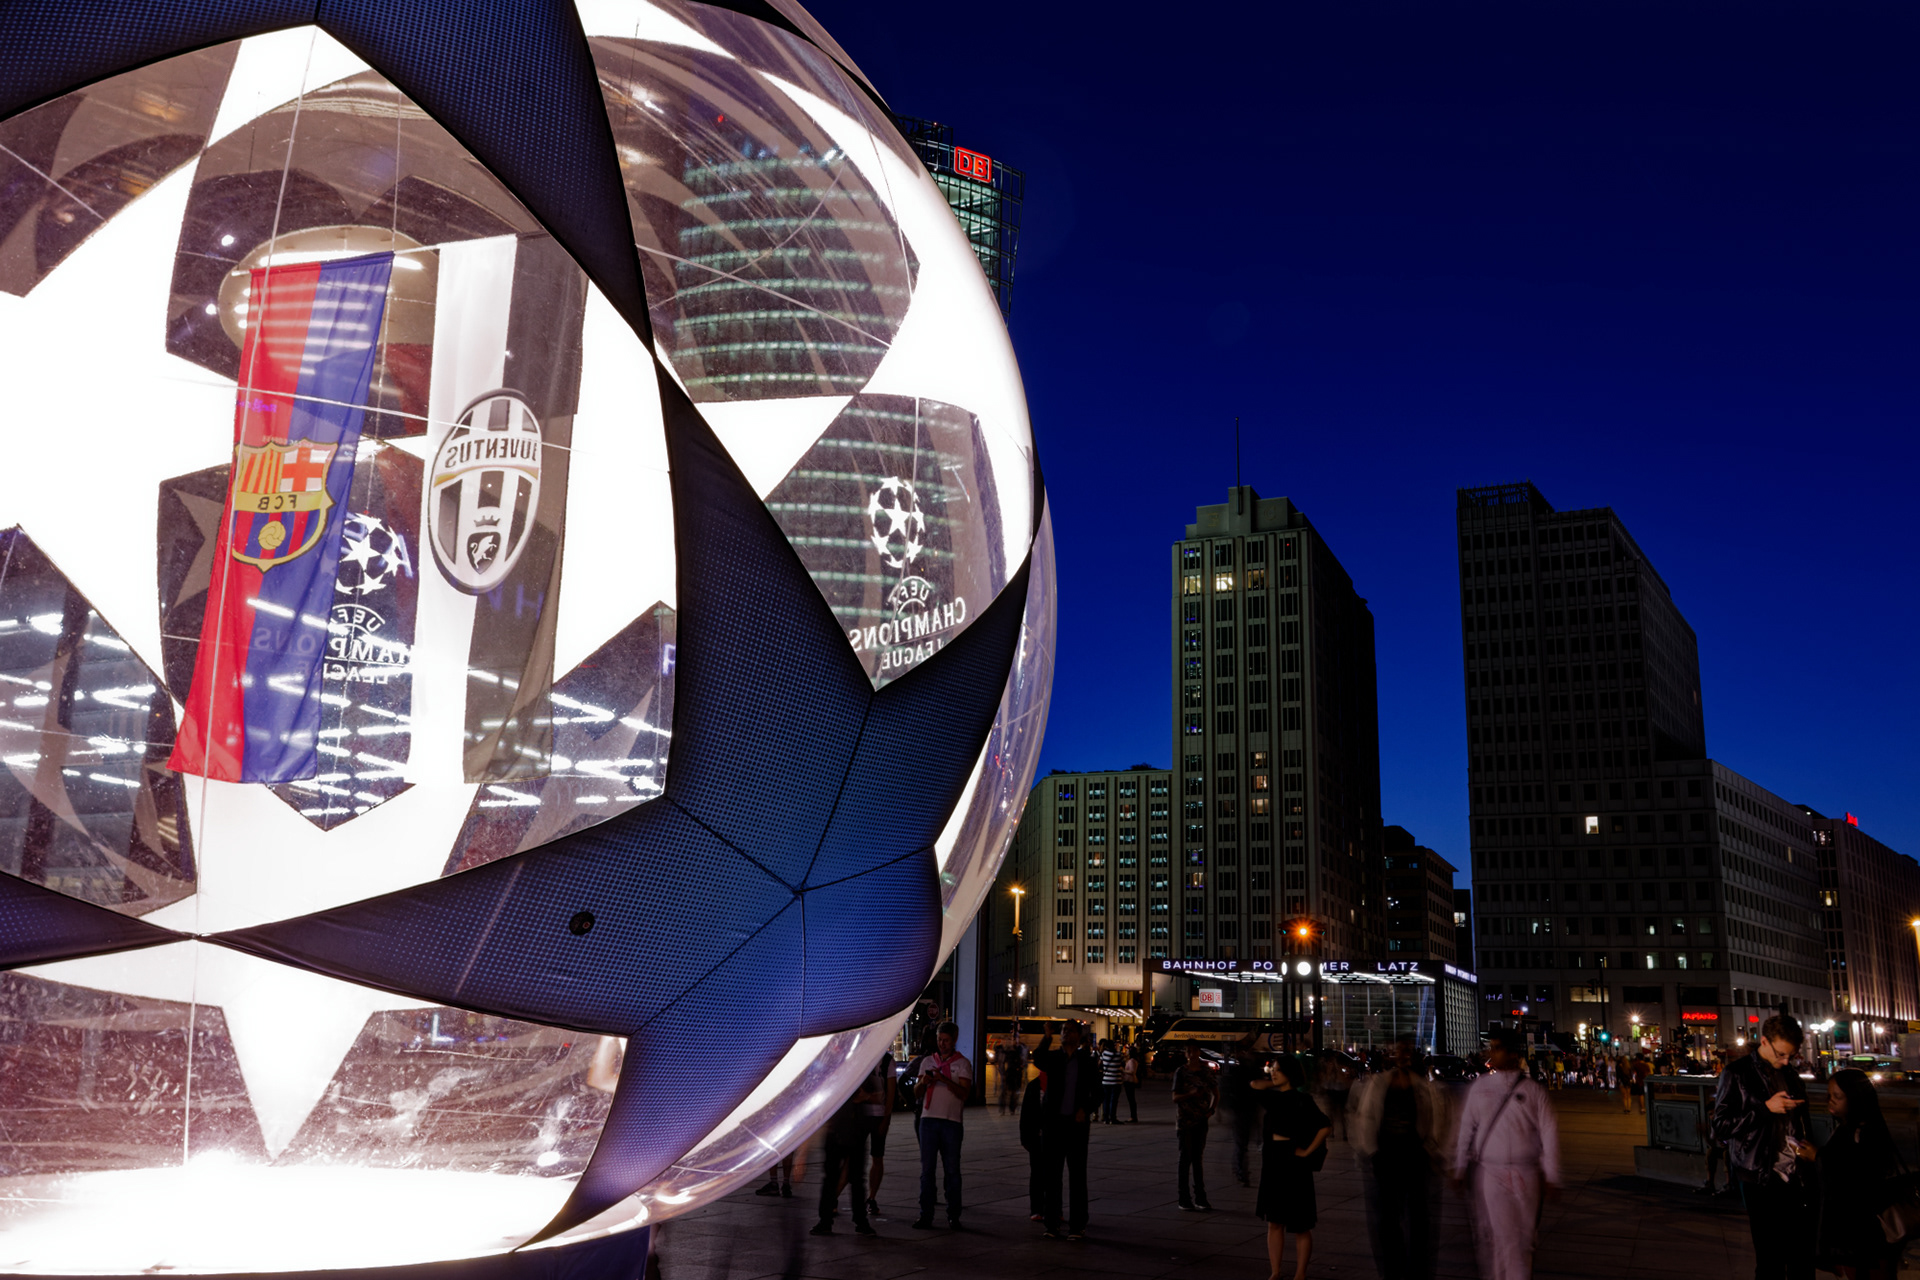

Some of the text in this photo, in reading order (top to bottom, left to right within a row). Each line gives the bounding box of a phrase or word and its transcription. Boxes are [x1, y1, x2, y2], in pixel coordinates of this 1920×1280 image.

[957, 150, 989, 179] DB
[1162, 960, 1237, 970] BAHNHOF
[1201, 993, 1213, 1002] DB
